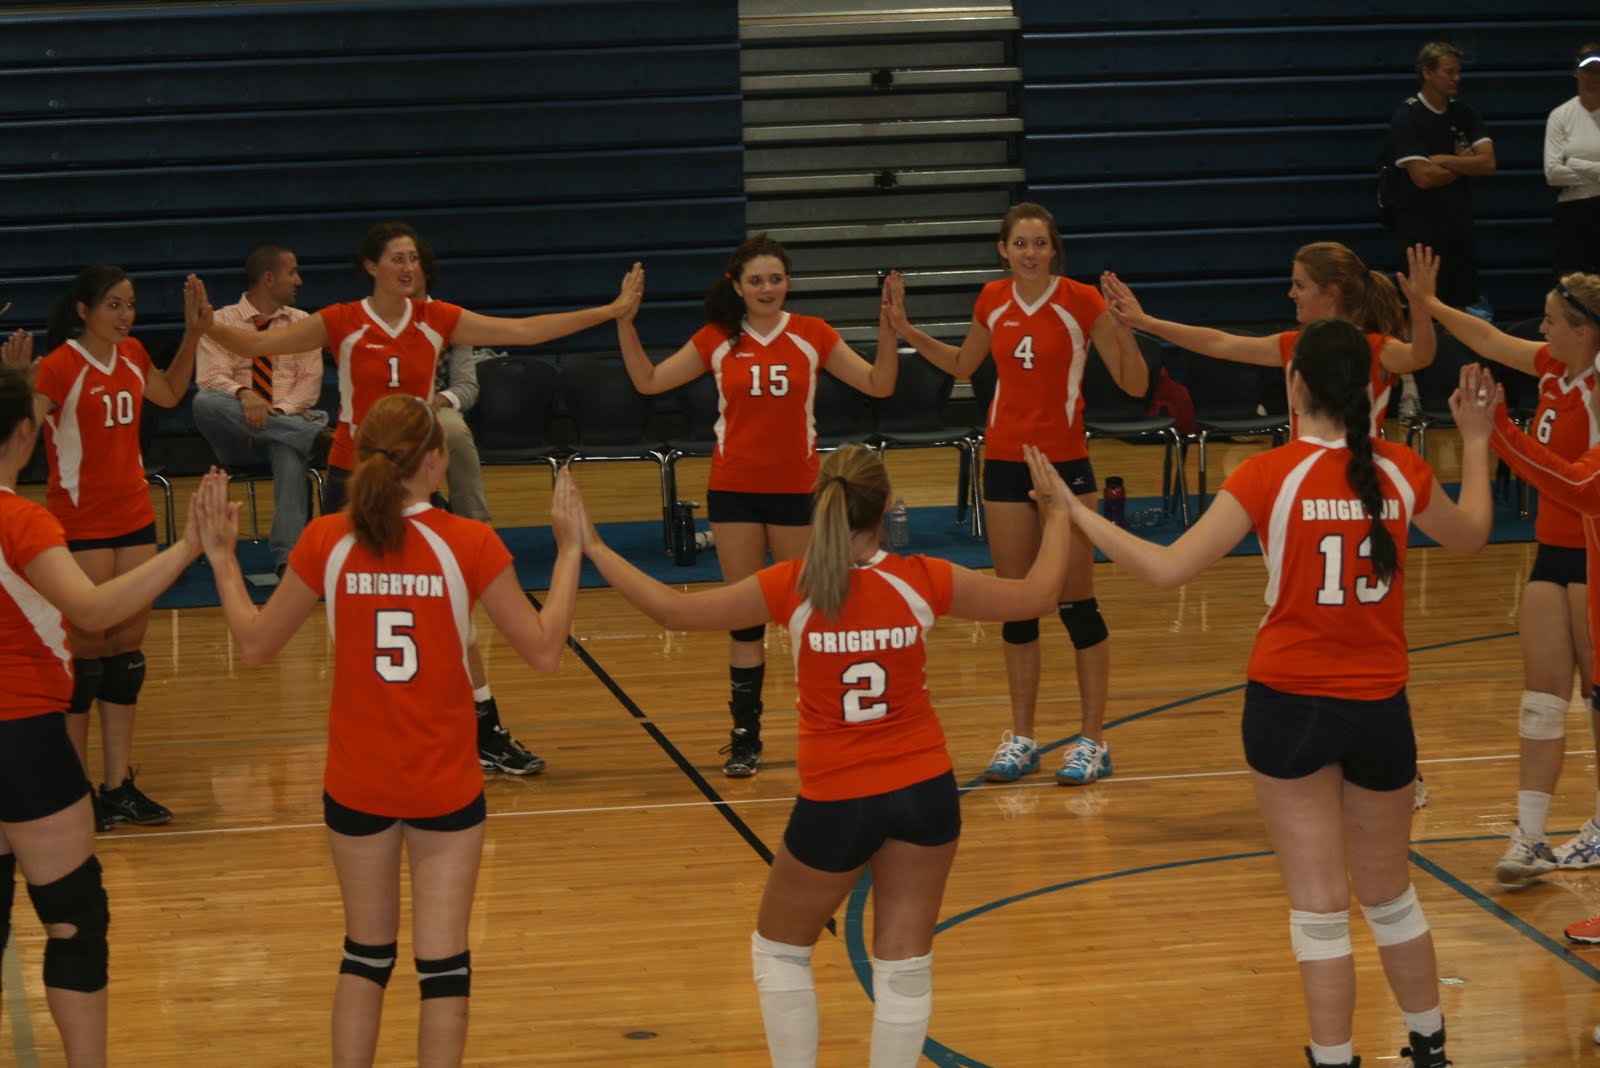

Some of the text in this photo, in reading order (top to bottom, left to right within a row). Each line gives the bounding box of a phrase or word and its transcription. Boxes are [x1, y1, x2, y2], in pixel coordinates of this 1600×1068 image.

[1013, 335, 1035, 370] 4
[388, 356, 401, 388] 1
[750, 364, 789, 397] 15
[102, 390, 134, 427] 10
[1536, 408, 1557, 445] 6
[1302, 499, 1400, 521] BRIGHON
[345, 572, 444, 597] BRIGHTON
[375, 610, 419, 683] 5
[808, 625, 918, 653] BRIGHTON
[841, 660, 889, 723] 2
